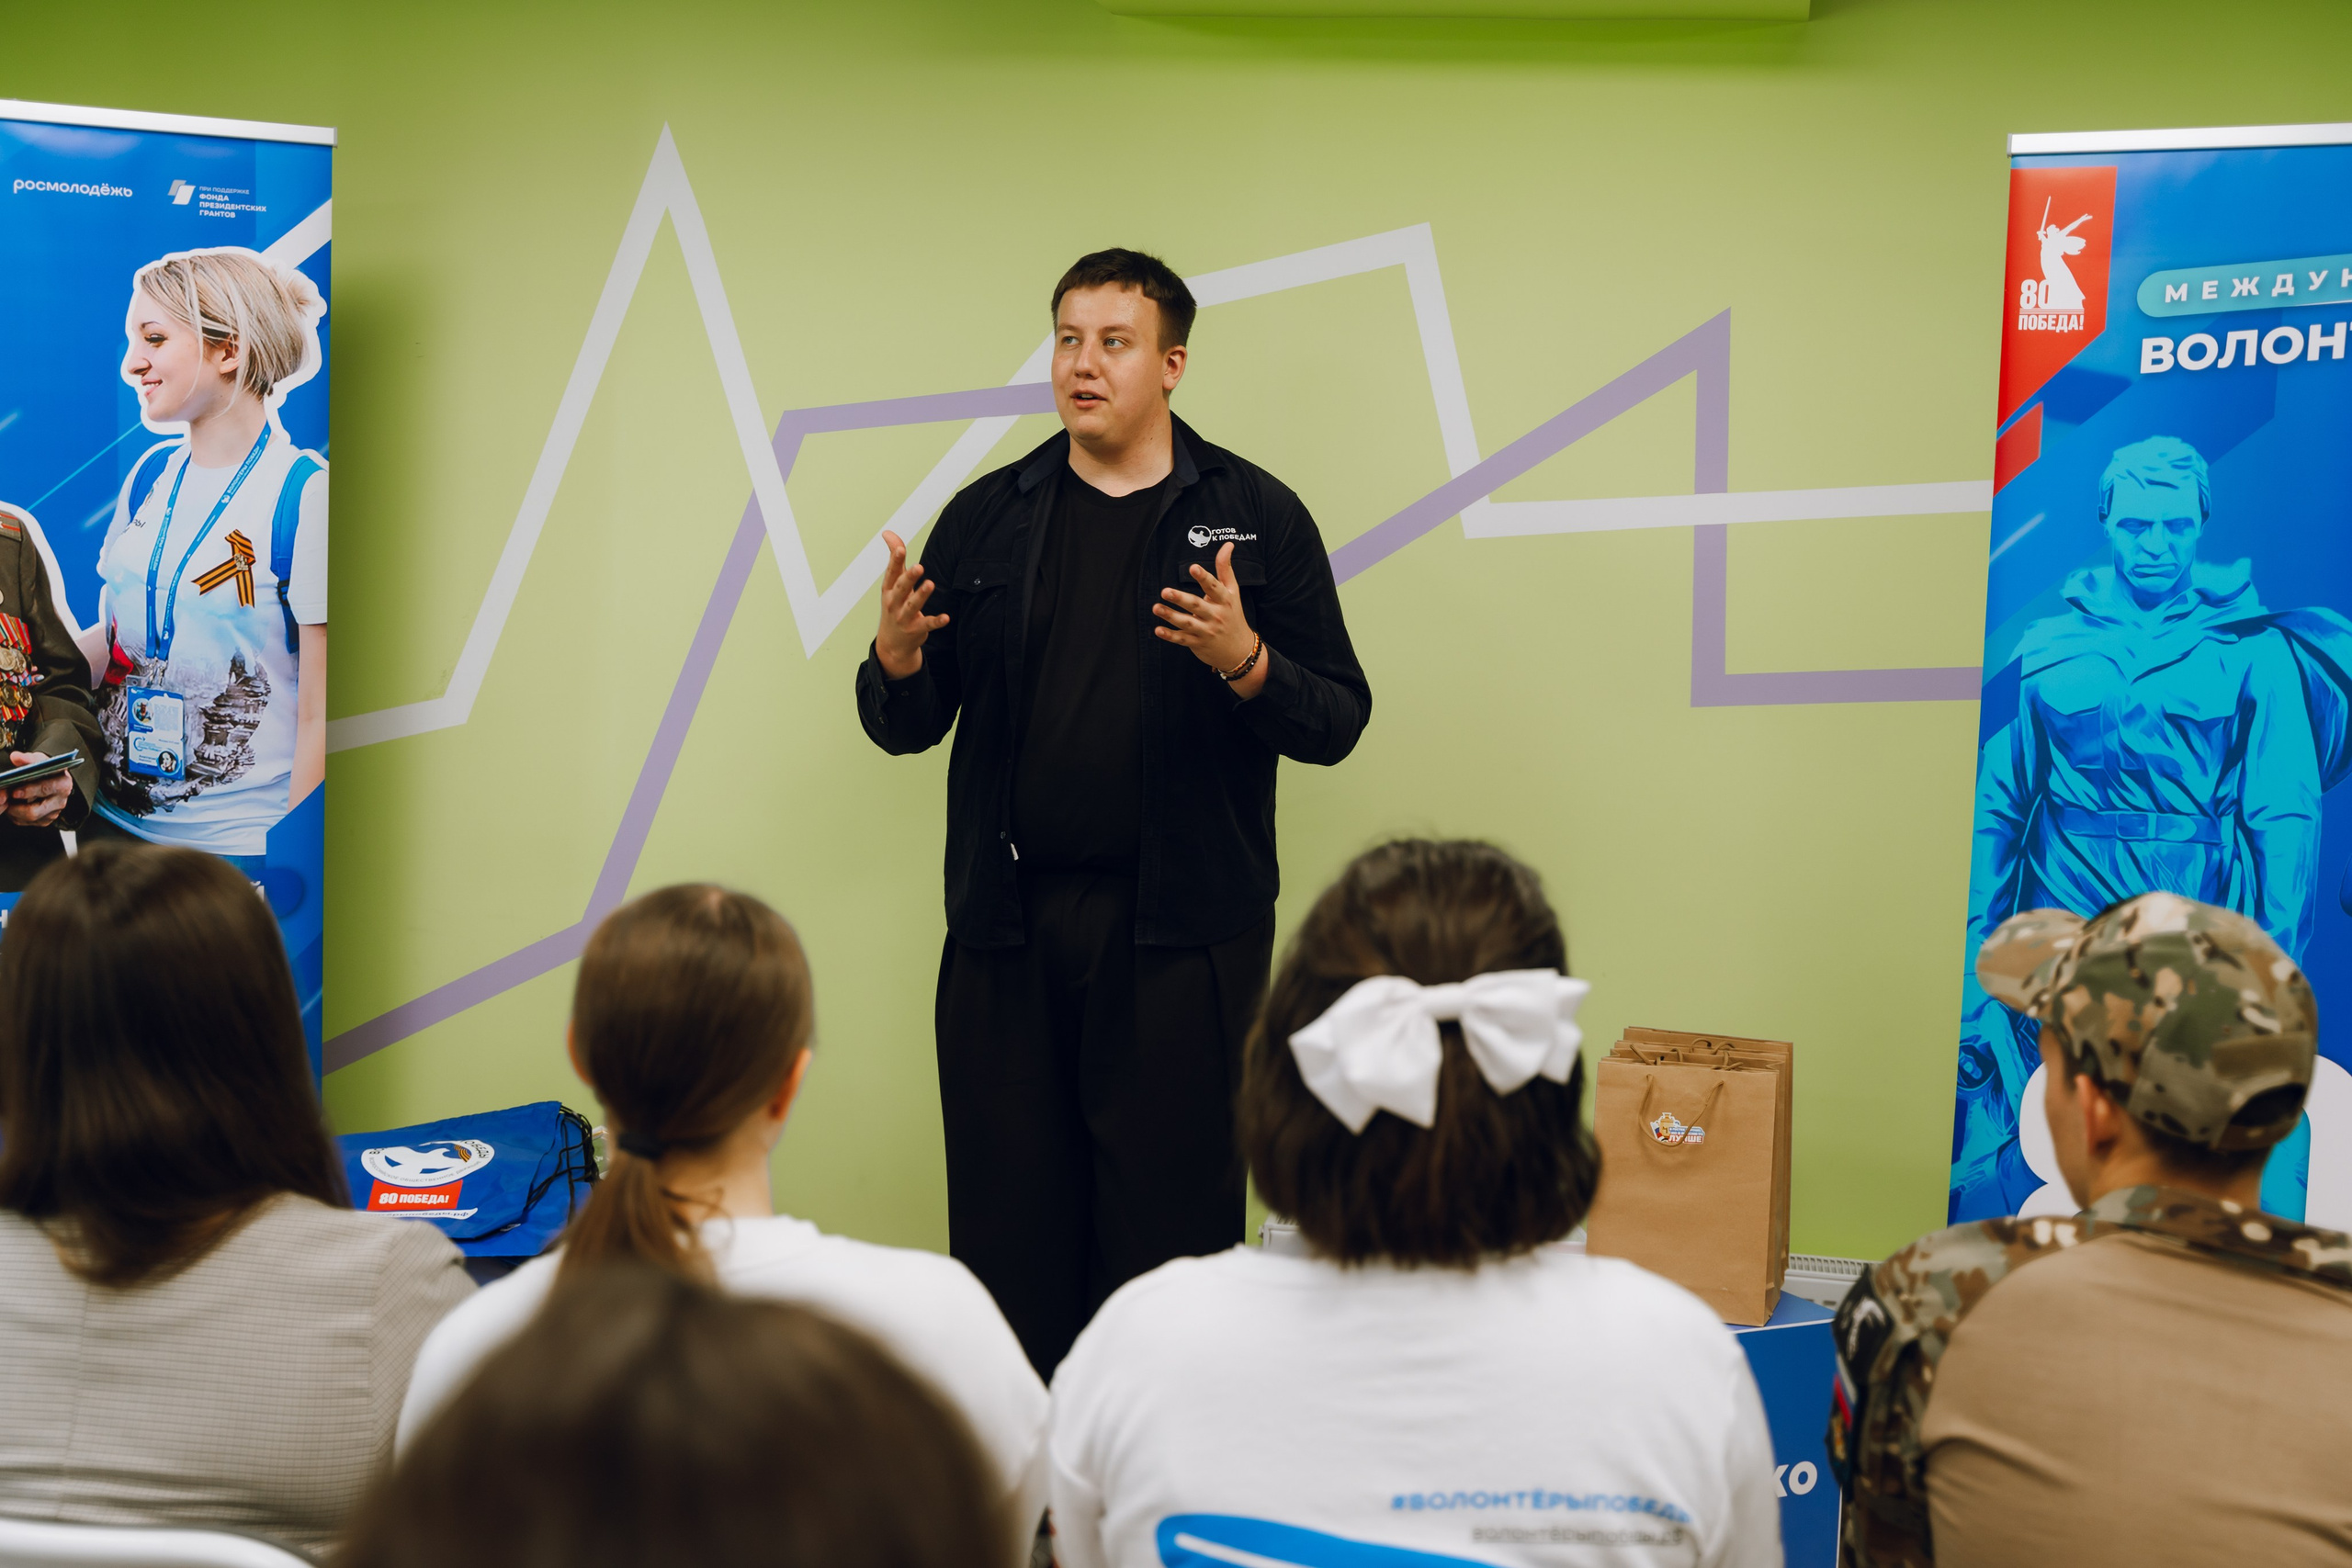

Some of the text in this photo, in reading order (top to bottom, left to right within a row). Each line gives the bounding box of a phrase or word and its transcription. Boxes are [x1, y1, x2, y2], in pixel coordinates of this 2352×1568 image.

[13, 178, 133, 197] росмолодёжь
[212, 186, 250, 195] ПОДДЕРЖКЕ
[198, 193, 230, 202] ФОНДА
[198, 201, 266, 212] ПРЕЗИДЕНТСКИХ
[198, 209, 236, 219] ГРАНТОВ
[2019, 278, 2050, 310] 80
[2018, 314, 2085, 333] ПОБЕДА!
[2140, 321, 2352, 374] ВОЛОН
[379, 1192, 449, 1205] 80 ПОБЕДА!
